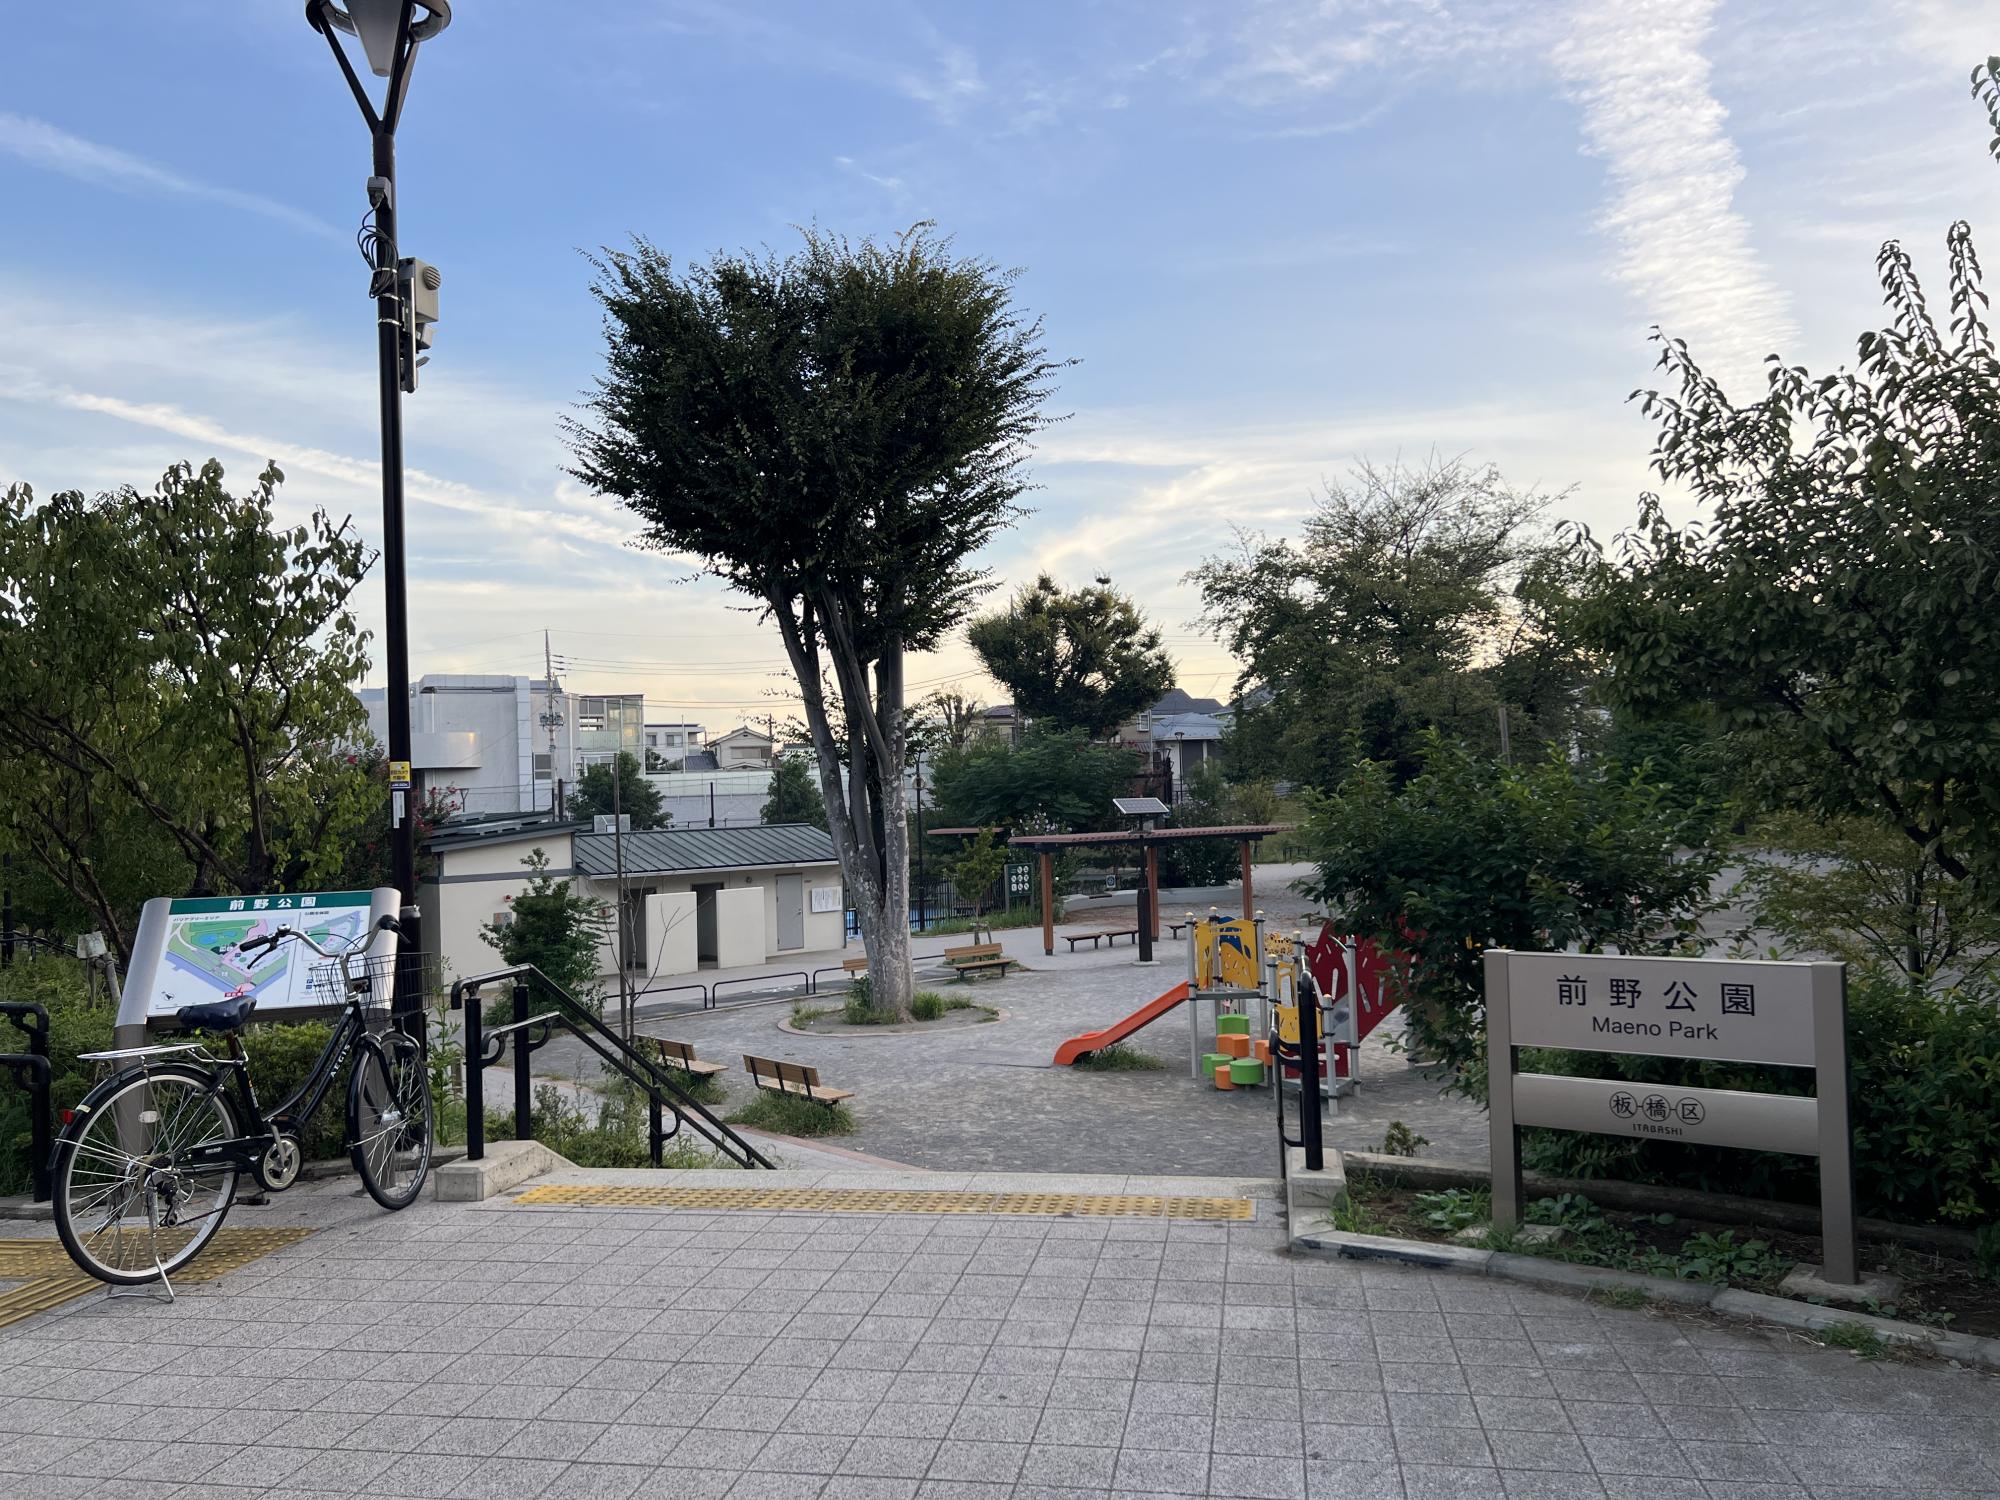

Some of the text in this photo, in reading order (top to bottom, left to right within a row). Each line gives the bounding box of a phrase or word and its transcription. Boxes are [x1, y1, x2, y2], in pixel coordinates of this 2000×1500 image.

[229, 896, 317, 911] 前野公園
[1556, 974, 1756, 1017] 前野公園
[1592, 1016, 1718, 1040] Maeno Park
[330, 1044, 351, 1078] AEGIS
[1611, 1092, 1703, 1123] 板橋区
[1632, 1123, 1683, 1136] ITABASHI
